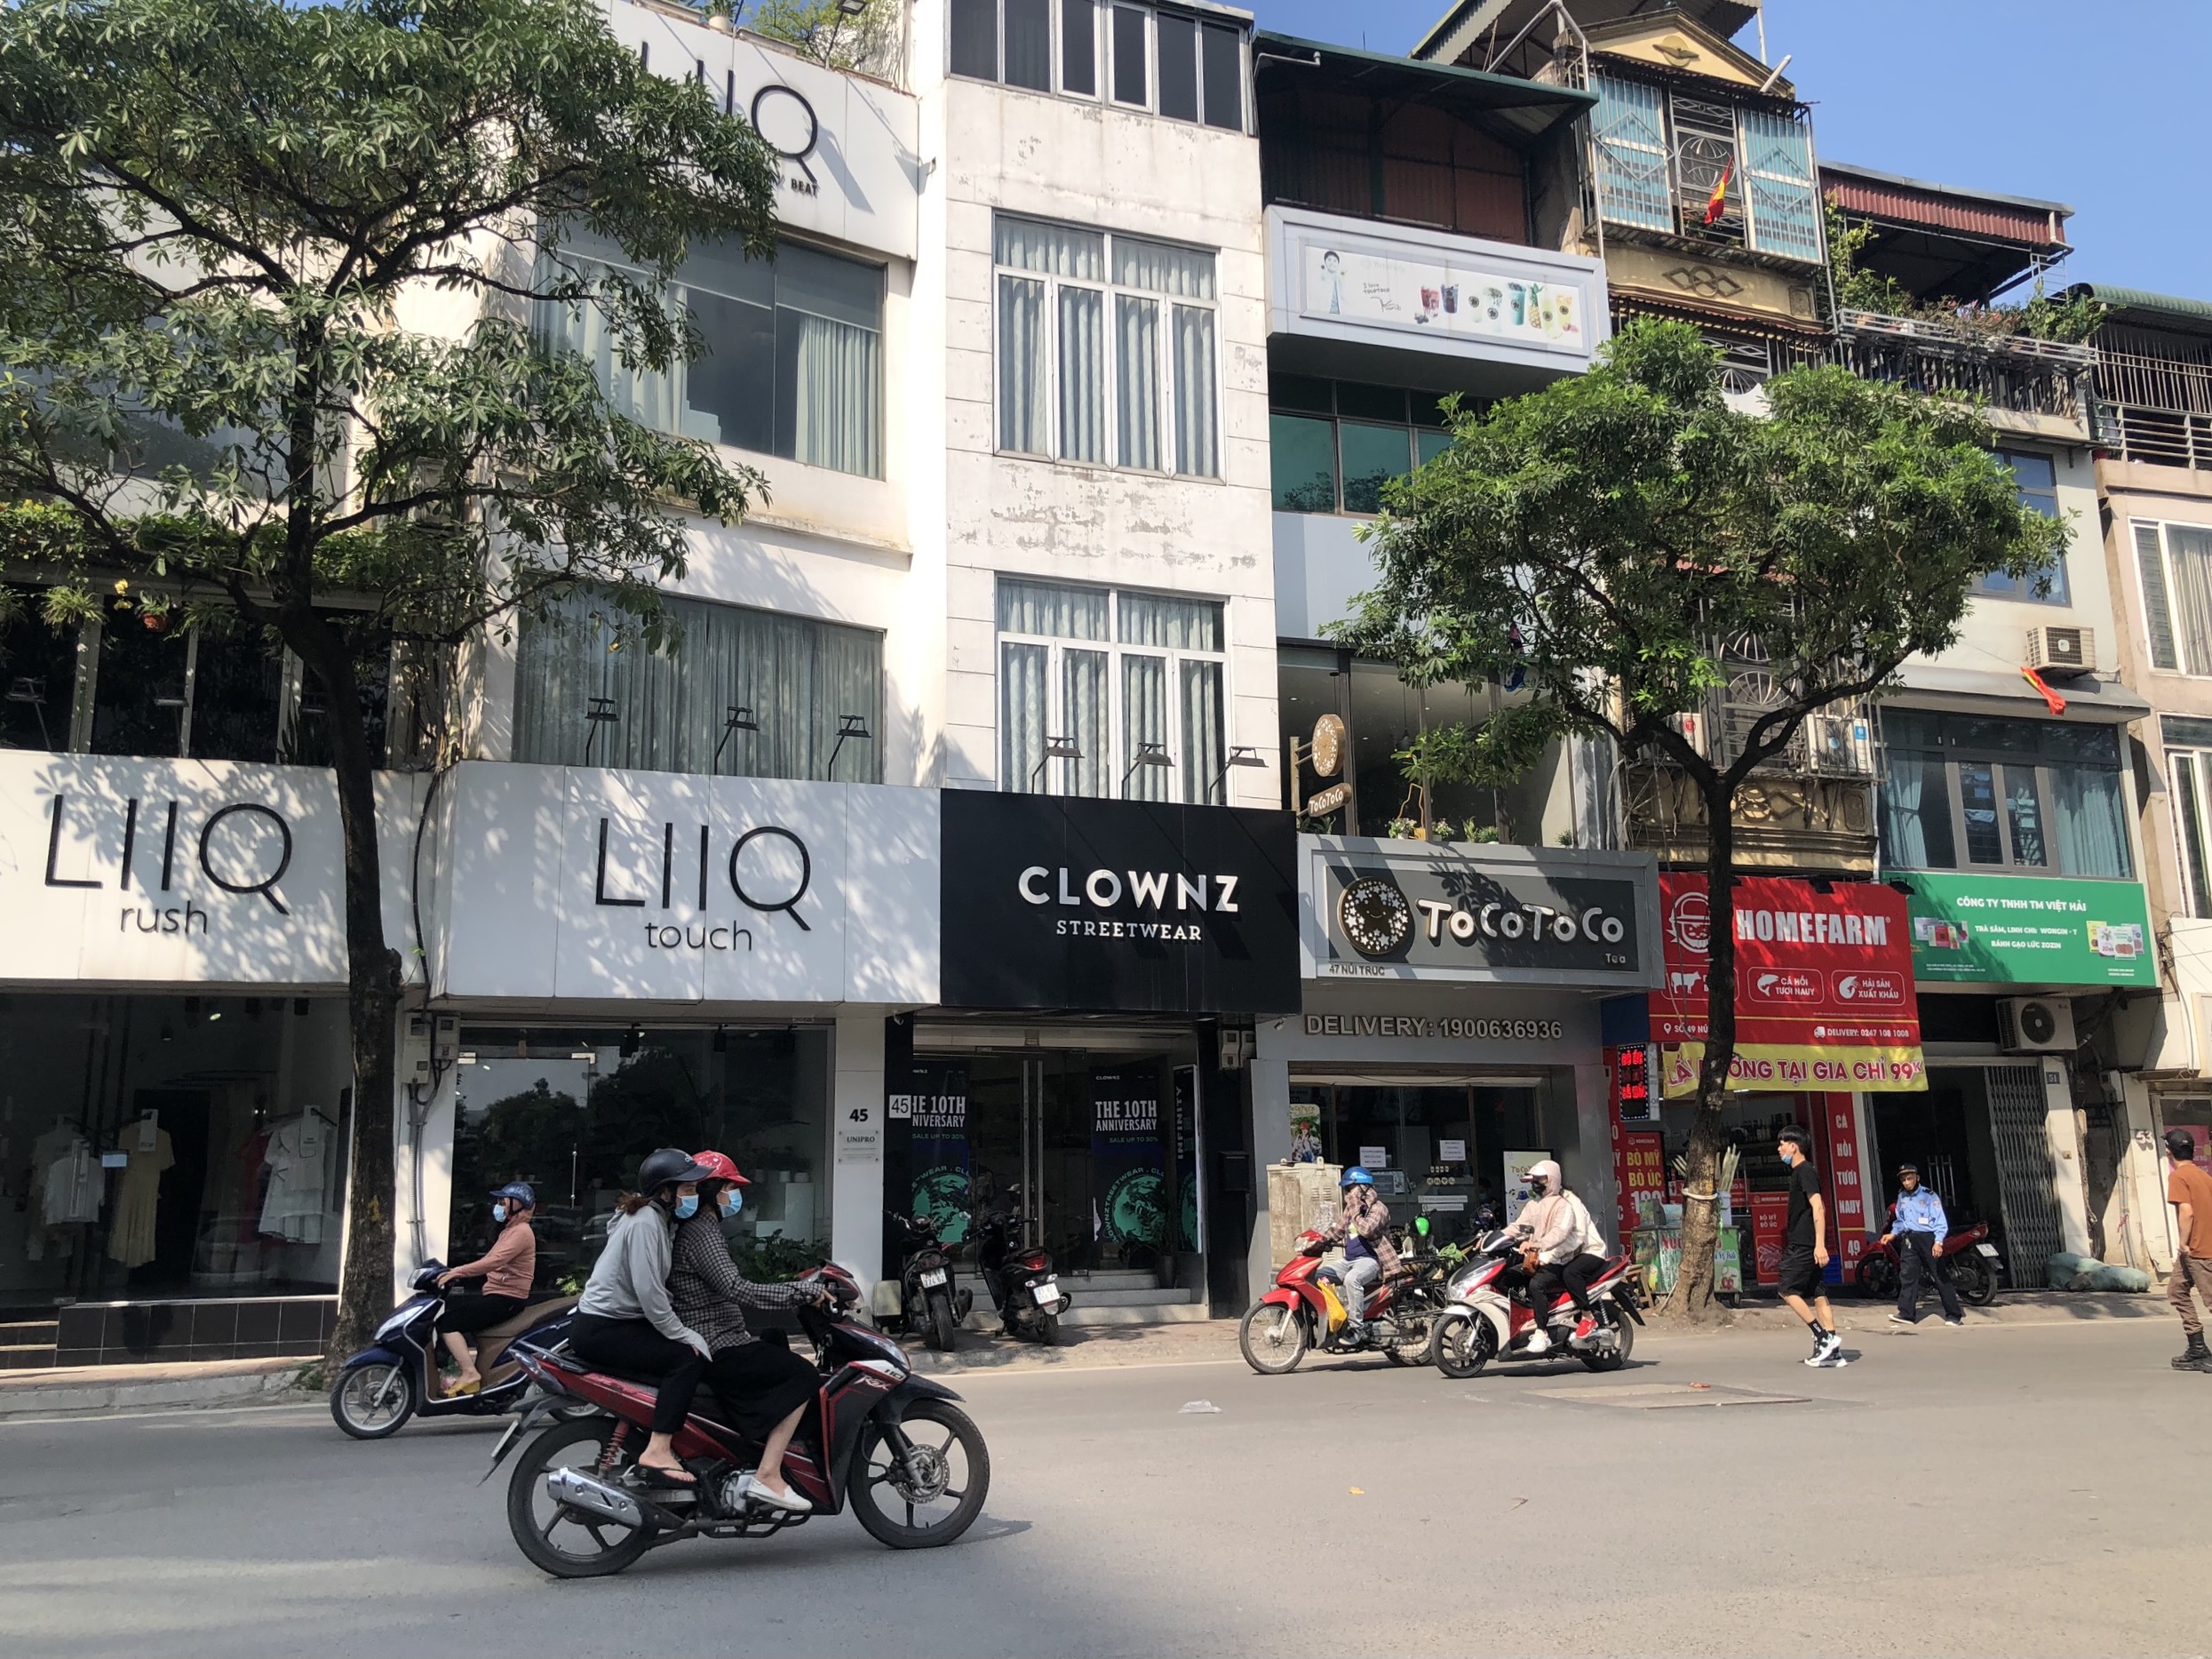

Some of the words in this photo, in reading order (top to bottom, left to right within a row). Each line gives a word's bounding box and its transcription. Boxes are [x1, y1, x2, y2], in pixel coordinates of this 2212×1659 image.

[791, 178, 818, 197] BEAT
[45, 794, 292, 916] LIIQ
[595, 818, 811, 931] LIIQ
[1018, 865, 1239, 913] CLOWNZ
[1956, 896, 1985, 907] CÔNG
[1985, 898, 1999, 908] TY
[2001, 899, 2028, 909] TNHH
[2029, 900, 2044, 909] TM
[2045, 899, 2067, 913] VIỆT
[2069, 900, 2087, 912] HẢI
[120, 900, 208, 935] rush
[645, 920, 752, 951] touch
[1056, 920, 1201, 941] STREETWEAR
[1736, 909, 1887, 946] HOMEFARM
[1605, 953, 1627, 964] Tea
[1329, 964, 1340, 974] 47
[1341, 962, 1357, 975] NÚI
[1780, 974, 1793, 985] CÁ
[1794, 986, 1815, 997] NAUY
[1439, 1018, 1563, 1040] 1900636936
[1698, 1024, 1708, 1033] NÚ
[1827, 1028, 1859, 1038] DELIVERY:
[1880, 1029, 1891, 1038] 108
[1892, 1029, 1909, 1038] 1008
[1777, 1058, 1809, 1086] TẠI
[1812, 1059, 1850, 1081] GIA
[1852, 1055, 1888, 1081] CHỈ
[891, 1097, 909, 1113] 45
[912, 1095, 926, 1113] HE
[930, 1095, 967, 1114] 10TH
[1095, 1100, 1120, 1119] THE
[1124, 1099, 1158, 1119] 10TH
[848, 1107, 869, 1122] 45
[912, 1114, 966, 1128] NIVERSARY
[1835, 1113, 1848, 1129] CÁ
[1095, 1118, 1158, 1132] ANNIVERSARY
[2136, 1130, 2152, 1144] 53
[1627, 1147, 1642, 1167] BÒ
[1643, 1150, 1659, 1167] MỸ
[1628, 1168, 1645, 1187] BÒ
[1647, 1169, 1662, 1186] ÚC
[1839, 1200, 1861, 1214] NAUY
[1847, 1239, 1860, 1256] 49
